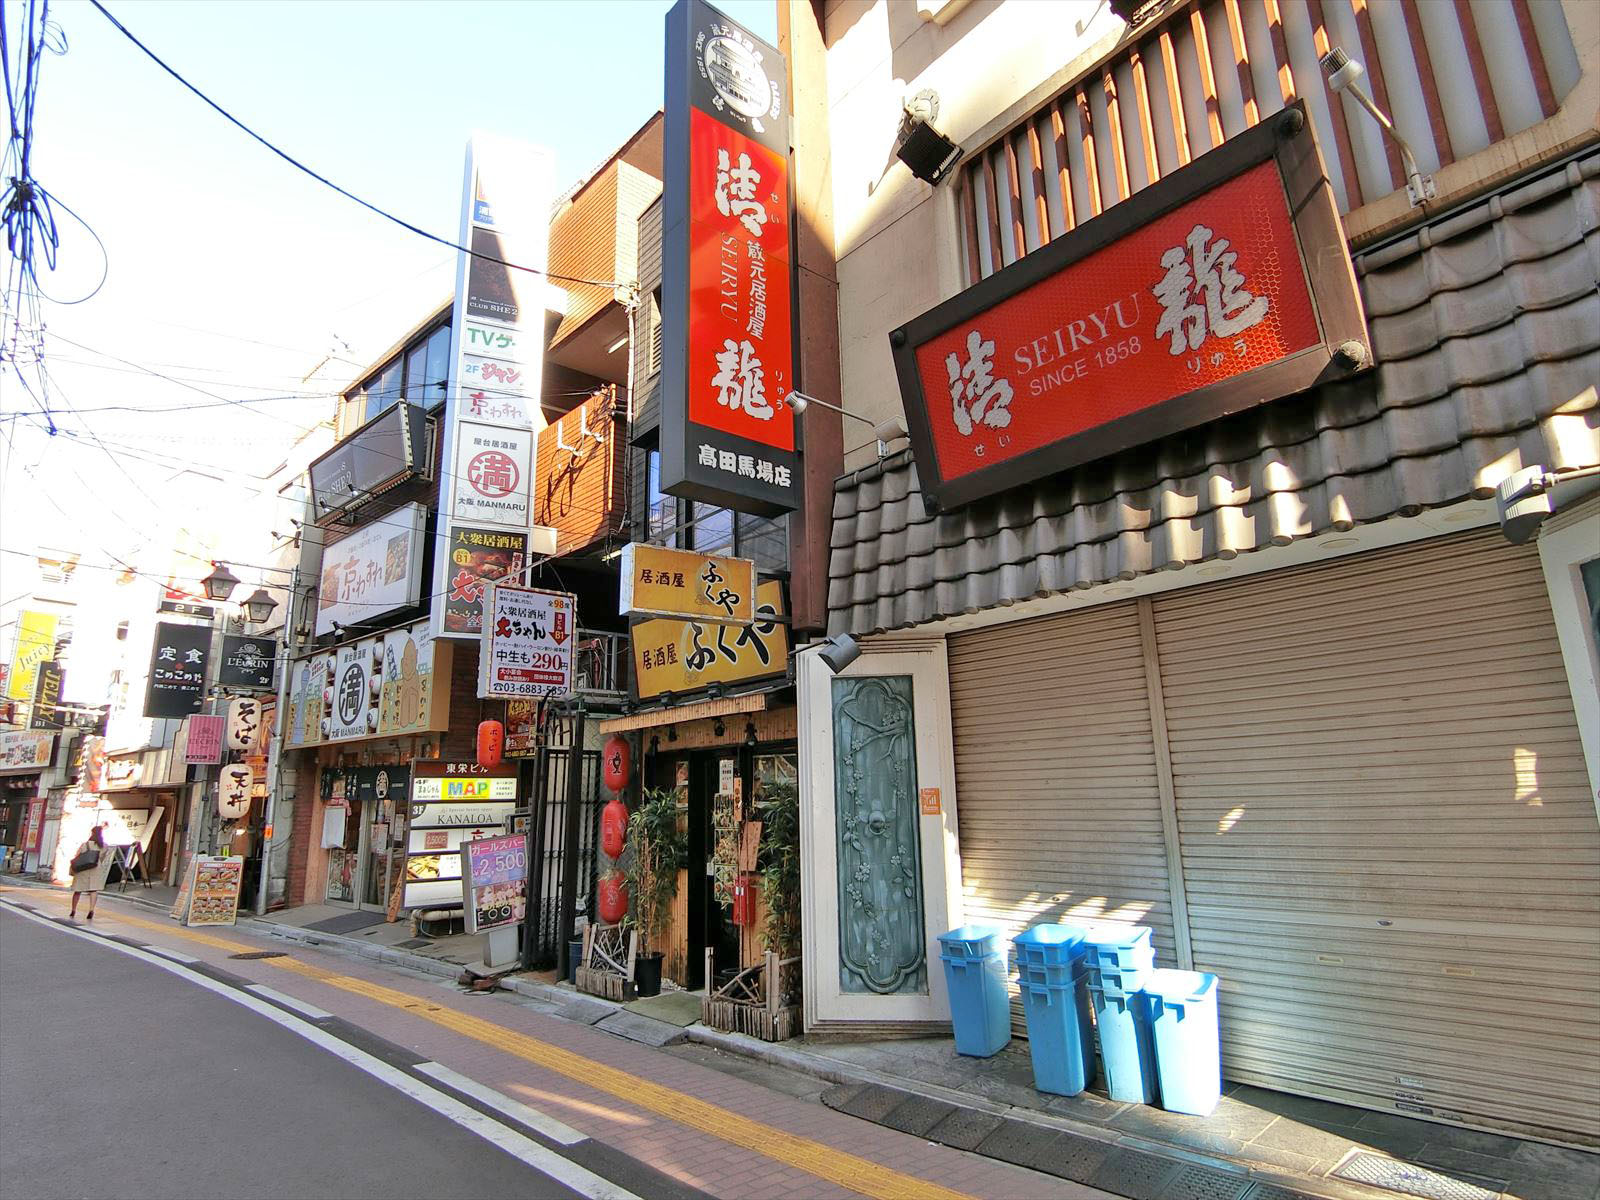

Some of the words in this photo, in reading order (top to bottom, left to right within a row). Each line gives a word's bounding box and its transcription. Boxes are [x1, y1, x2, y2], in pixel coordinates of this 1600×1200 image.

[770, 192, 780, 224] せい
[721, 231, 738, 323] SEIRYU
[746, 240, 767, 340] 蔵元居酒屋
[1152, 224, 1269, 357] 龍
[467, 327, 516, 349] TVゲ
[1013, 293, 1141, 376] SEIRYU
[1186, 338, 1248, 374] りゅう
[465, 364, 480, 374] 2F
[1030, 361, 1089, 397] SINCE
[1094, 336, 1142, 370] 1858
[711, 338, 775, 421] 龍
[774, 369, 785, 411] りゅう
[473, 438, 518, 451] 屋台居酒屋
[973, 434, 1011, 458] せい
[469, 453, 516, 496] 満
[477, 500, 526, 512] MANMARU
[456, 531, 523, 549] 大衆居酒屋
[456, 554, 468, 563] B1
[640, 569, 685, 588] 居酒屋
[701, 561, 740, 616] ふくや
[174, 604, 201, 614] 2F
[497, 605, 547, 620] 大衆居酒屋
[555, 631, 564, 640] B1
[19, 643, 50, 672] Juicy
[158, 646, 203, 664] 定食
[642, 643, 679, 671] 居酒屋
[259, 676, 269, 684] 2F
[446, 763, 489, 774] 東栄ビル
[448, 782, 489, 796] MAP
[413, 805, 424, 815] 3F
[437, 813, 493, 825] KANALOA
